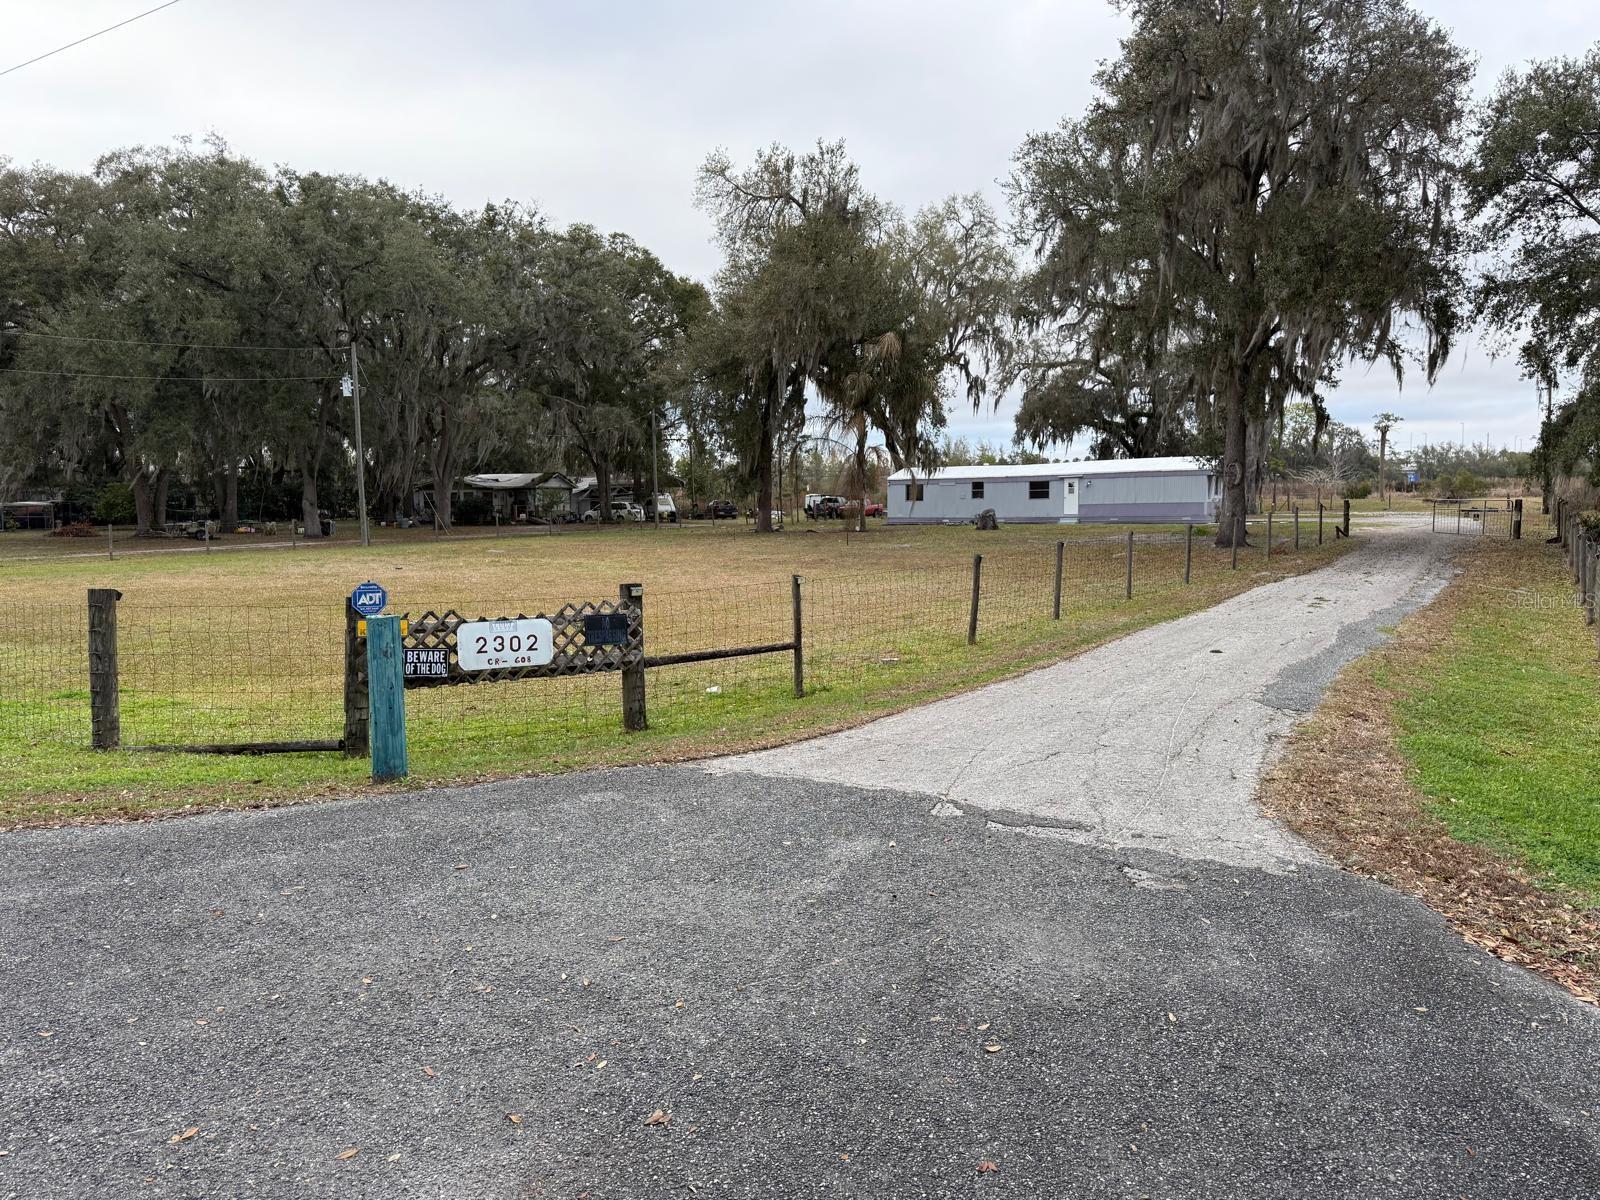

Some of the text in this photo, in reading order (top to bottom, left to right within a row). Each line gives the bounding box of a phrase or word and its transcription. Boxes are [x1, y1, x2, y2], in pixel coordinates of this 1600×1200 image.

[358, 593, 382, 605] ADT
[475, 634, 538, 654] 2302
[406, 650, 446, 663] BEWARE
[514, 656, 532, 665] 608
[405, 662, 447, 675] OF THE DOG
